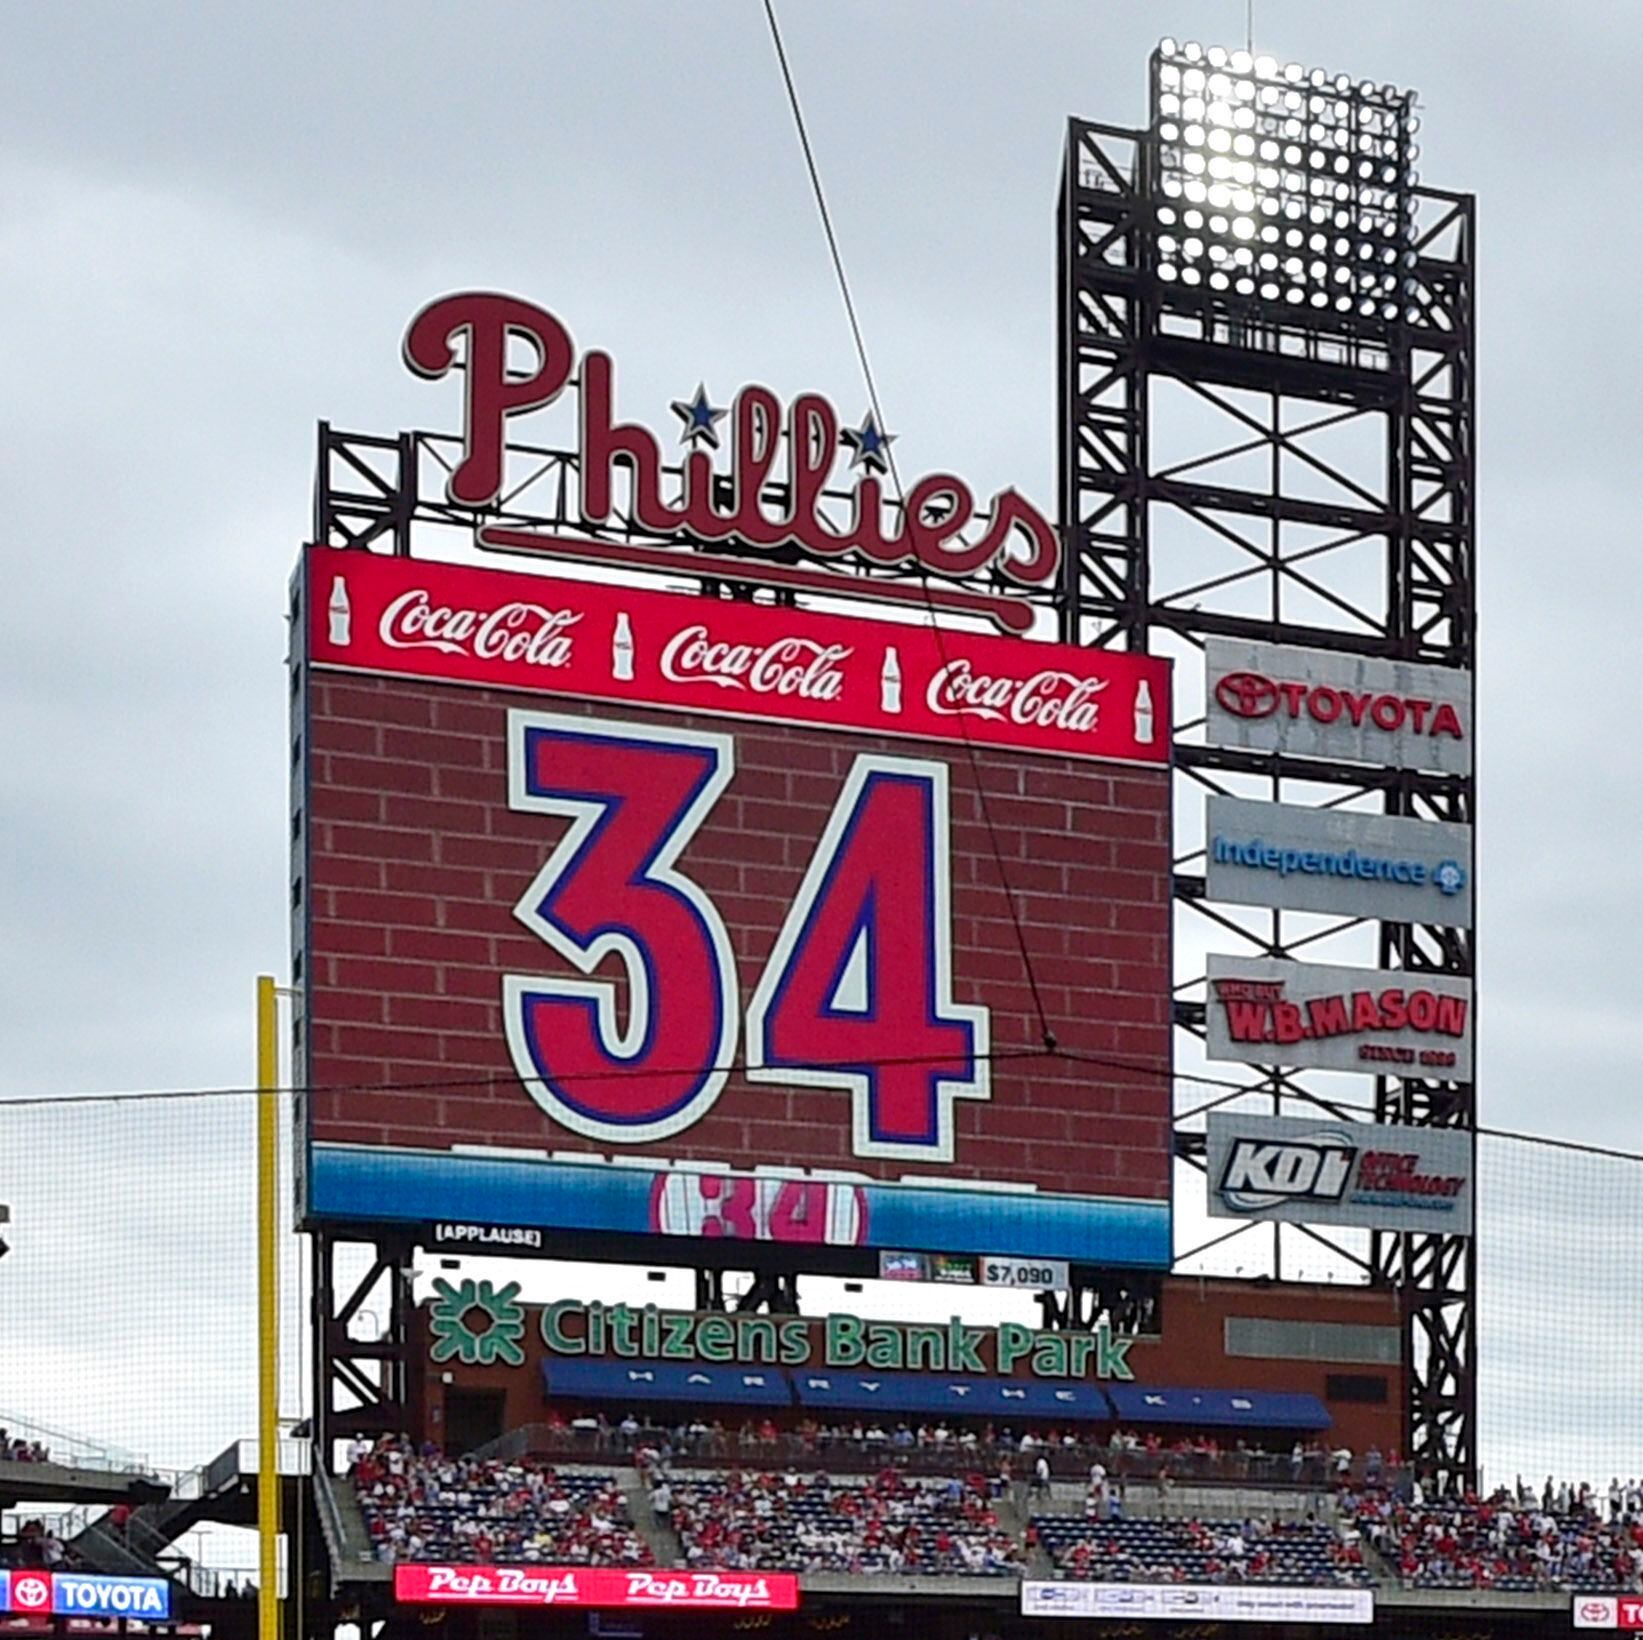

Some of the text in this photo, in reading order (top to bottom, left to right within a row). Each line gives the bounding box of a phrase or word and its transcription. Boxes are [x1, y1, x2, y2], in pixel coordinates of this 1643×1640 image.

[402, 289, 1062, 586] Phillies
[379, 587, 587, 671] Coca-Cola
[660, 624, 856, 702] Coca-Cola
[926, 657, 1110, 733] Coca-Cola
[1280, 683, 1464, 739] TOYOTA
[1213, 833, 1427, 885] Independence
[502, 709, 991, 1163] 34
[1223, 1141, 1352, 1198] KDI
[986, 1263, 1054, 1285] $7,090
[541, 1298, 1136, 1381] Citizens Bank Park
[60, 1582, 163, 1611] TOYOTA
